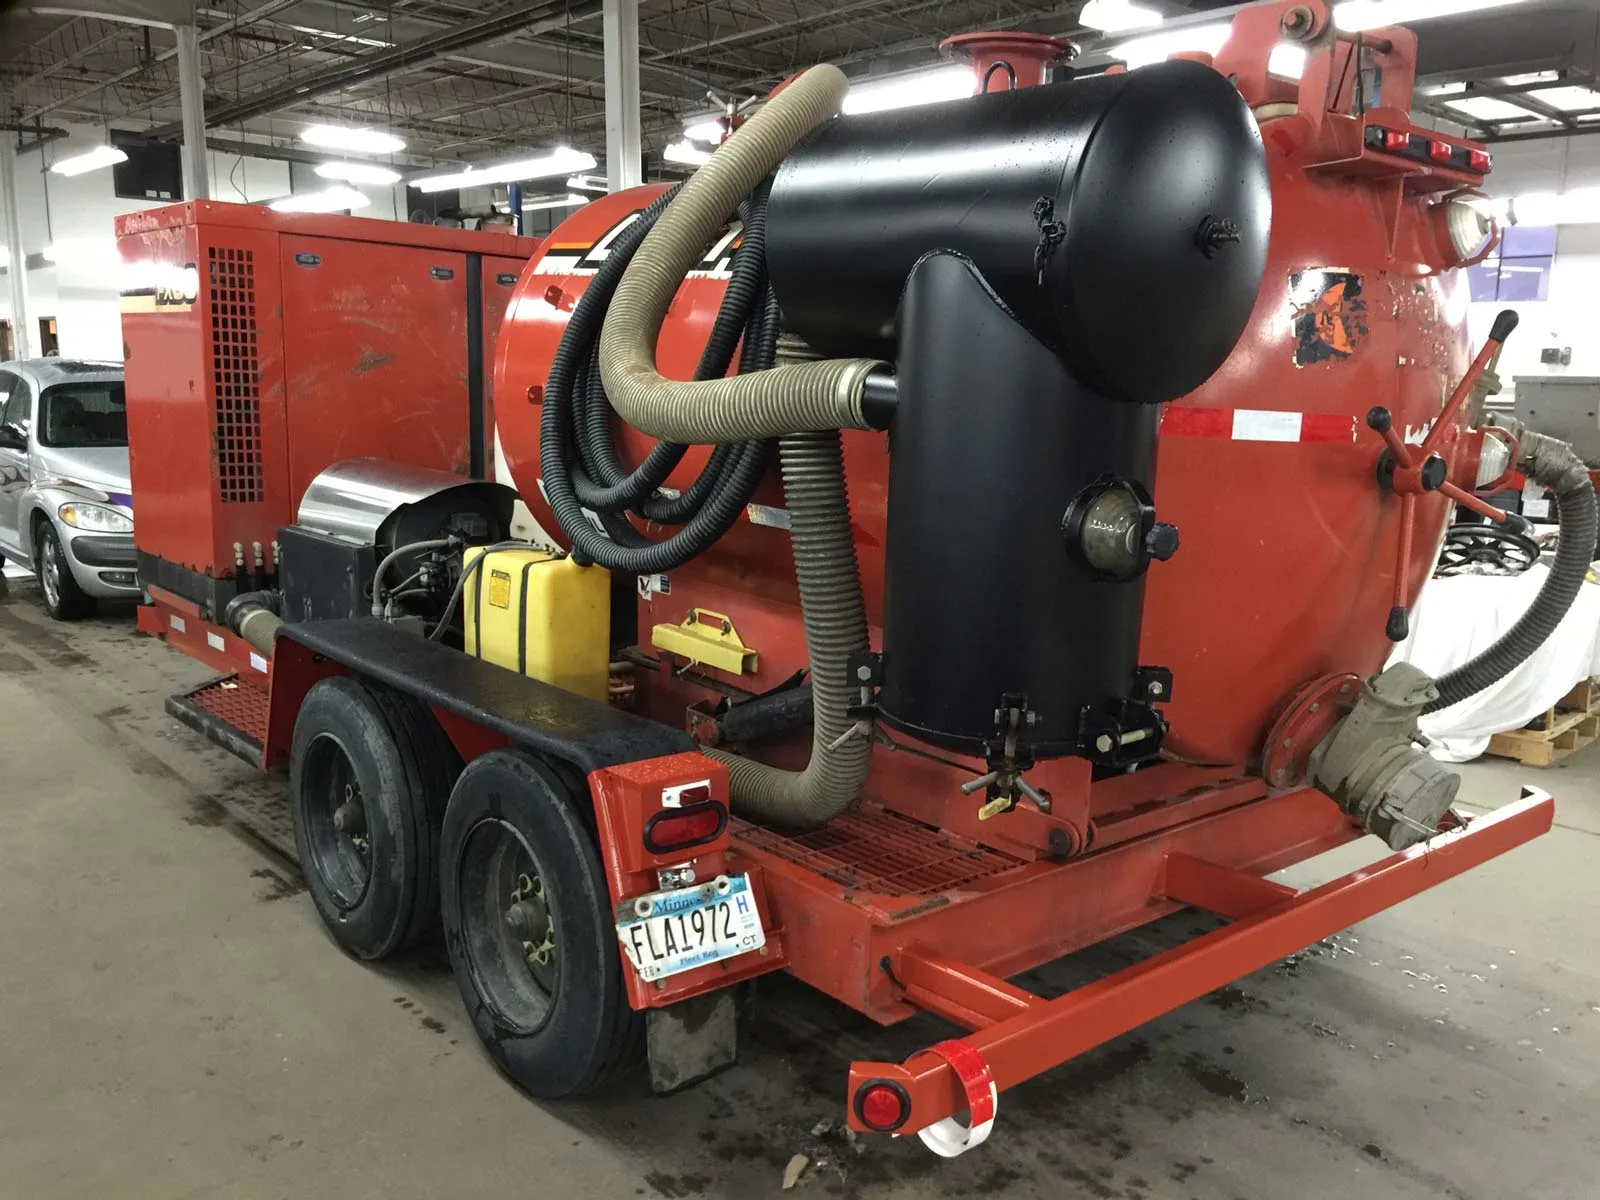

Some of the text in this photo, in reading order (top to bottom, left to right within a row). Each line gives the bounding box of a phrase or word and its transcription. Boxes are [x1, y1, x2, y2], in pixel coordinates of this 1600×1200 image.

[736, 895, 749, 914] H
[629, 901, 737, 965] FLA1972
[742, 934, 757, 946] CT
